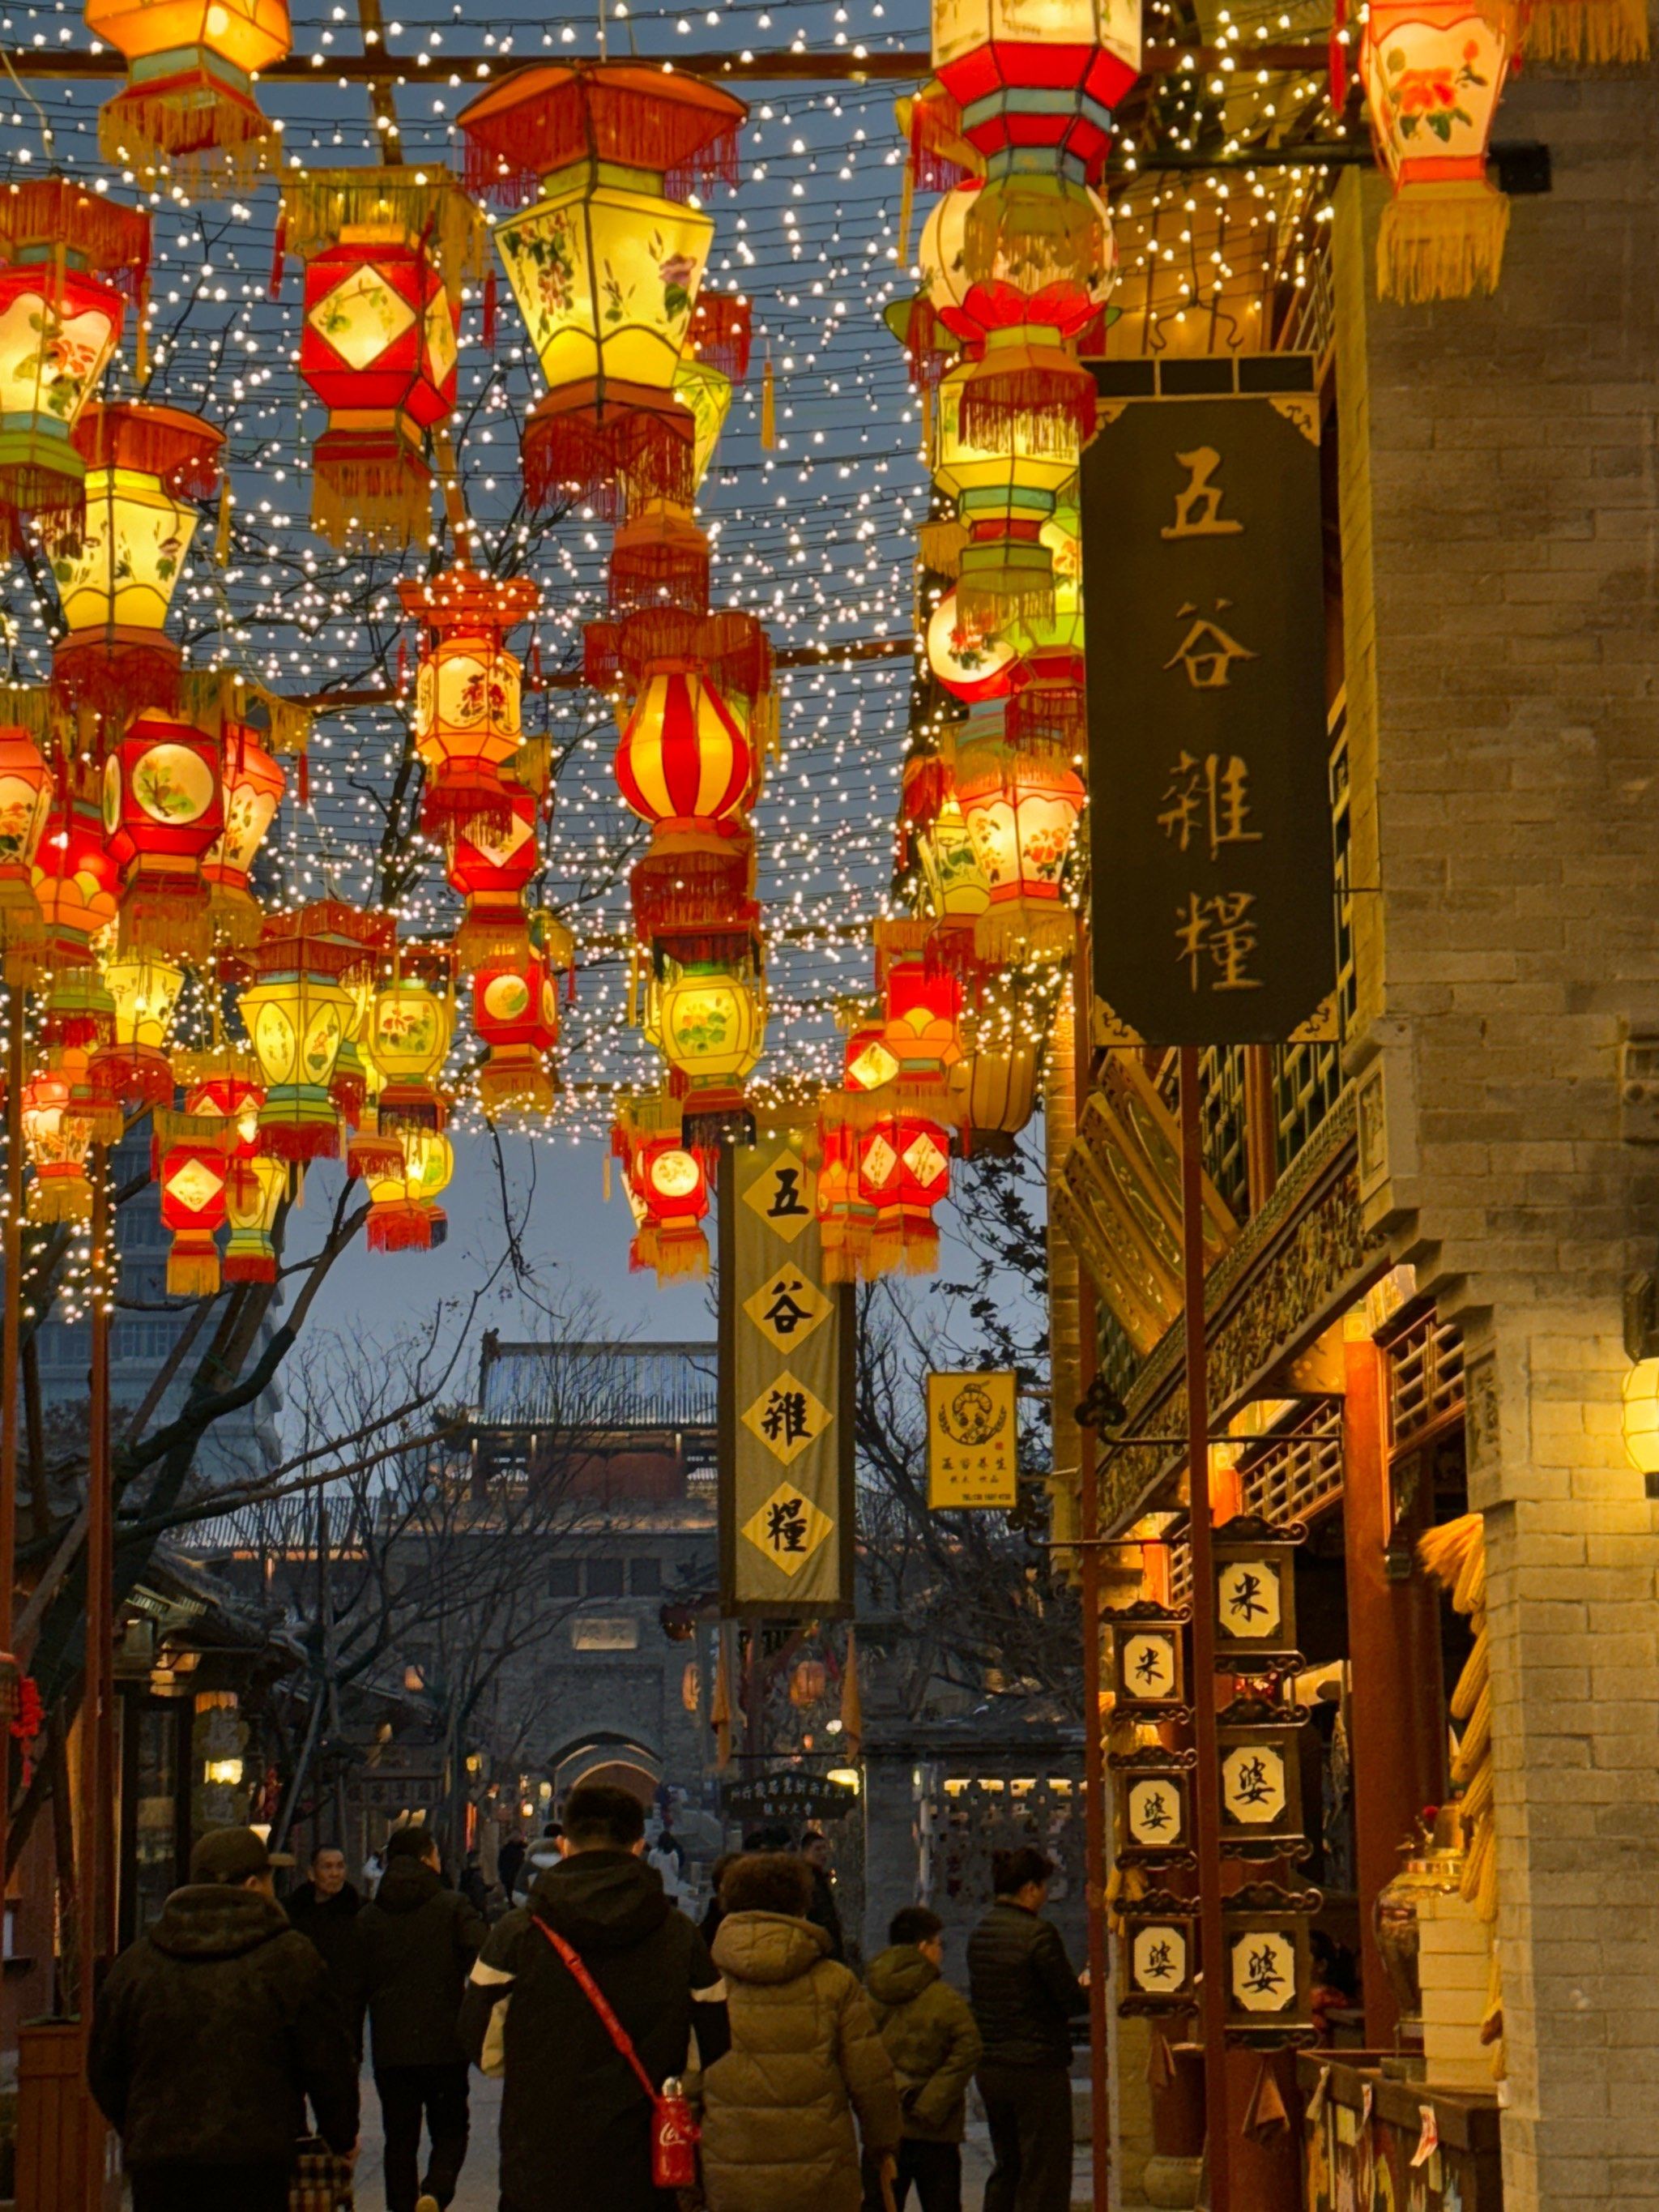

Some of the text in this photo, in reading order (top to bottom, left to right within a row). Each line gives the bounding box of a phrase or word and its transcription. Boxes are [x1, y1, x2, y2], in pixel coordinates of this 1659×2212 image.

[1158, 446, 1265, 993] 五谷雜糧
[762, 1168, 814, 1553] 五谷雜糧
[1229, 1572, 1269, 1623] 米
[1136, 1647, 1164, 1685] 米
[1231, 1756, 1276, 1805] 婆
[1140, 1792, 1172, 1830] 婆
[1143, 1941, 1177, 1979] 婆
[1241, 1944, 1286, 1995] 婆
